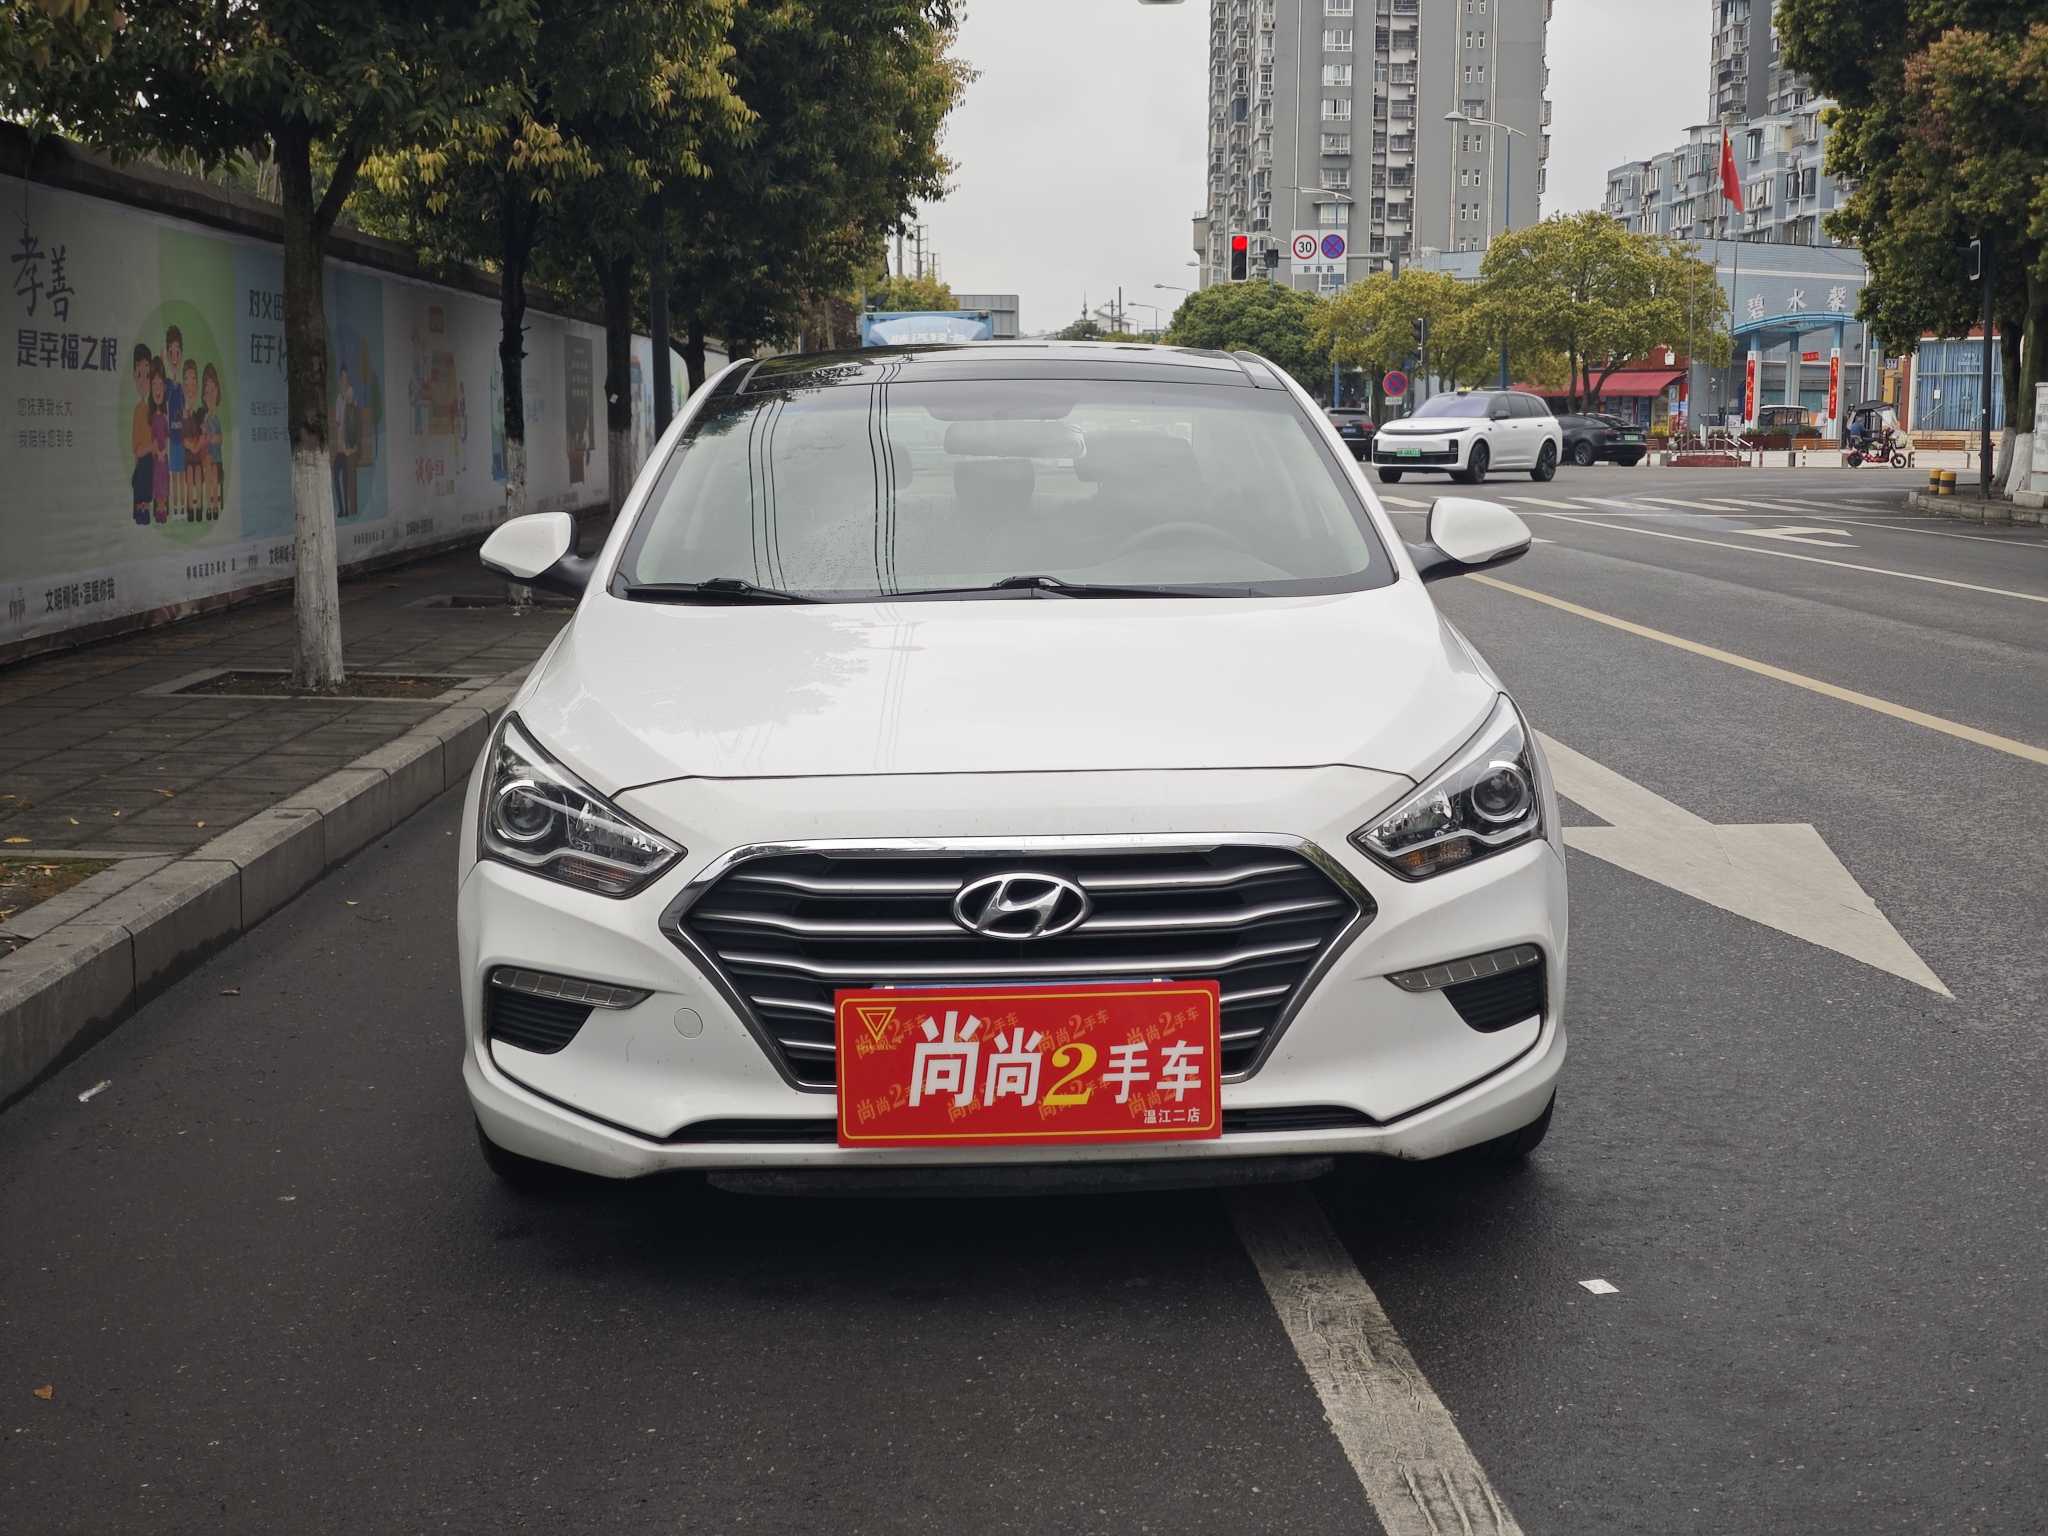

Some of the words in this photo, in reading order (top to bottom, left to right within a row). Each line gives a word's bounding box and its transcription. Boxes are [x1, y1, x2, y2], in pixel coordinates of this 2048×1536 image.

[1298, 241, 1312, 253] 30
[11, 226, 75, 322] 孝善
[17, 328, 118, 372] 是幸福之根
[908, 1011, 1204, 1107] 尚尚2手车
[1143, 1107, 1201, 1124] 温江二店
